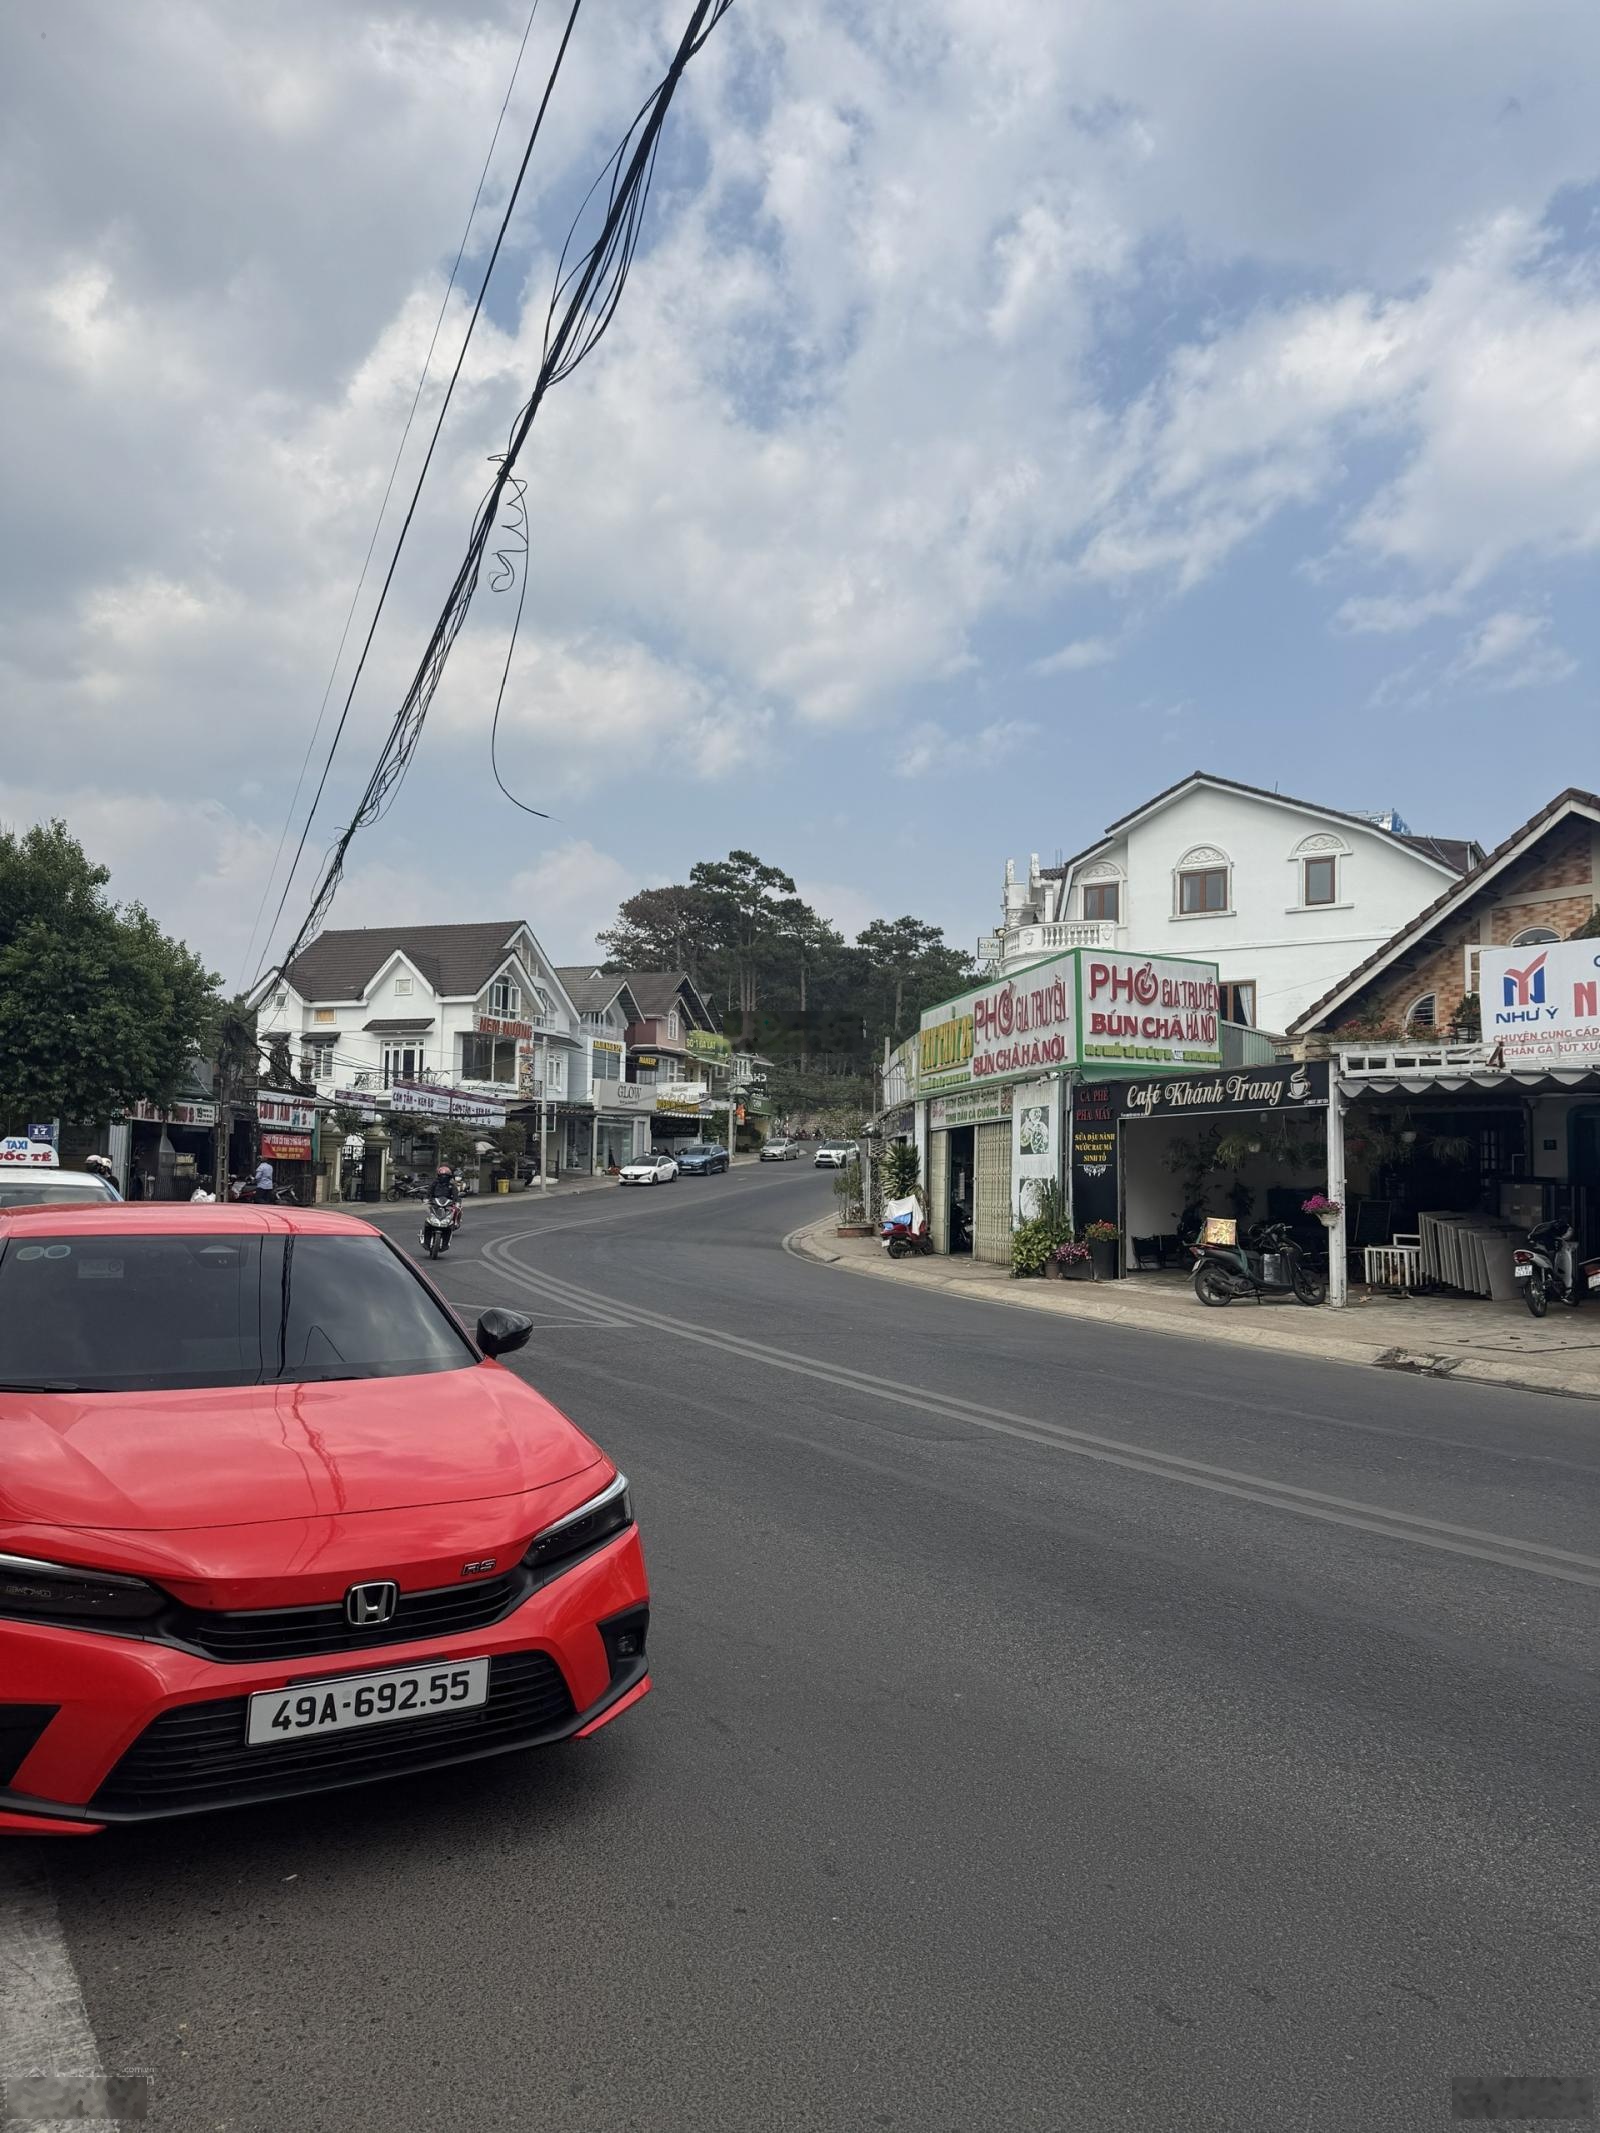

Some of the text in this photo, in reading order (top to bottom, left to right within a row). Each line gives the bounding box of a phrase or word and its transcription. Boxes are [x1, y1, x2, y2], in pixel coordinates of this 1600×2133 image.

[1090, 961, 1159, 1006] PHỞ
[1161, 978, 1180, 1007] GIA
[974, 980, 1016, 1044] PHỞ
[1015, 994, 1031, 1033] GIA
[1495, 1005, 1560, 1024] NHƯ Ý
[1090, 1008, 1138, 1037] BÚN
[1141, 1014, 1184, 1041] CHẢ
[1541, 1029, 1572, 1040] CUNG
[1575, 1025, 1600, 1038] CẤP
[973, 1049, 998, 1077] BÚN
[617, 1085, 642, 1099] GLOW
[1127, 1074, 1283, 1116] Café Khánh Trang
[33, 1127, 48, 1135] 17
[6, 1140, 28, 1150] TAXI
[31, 1150, 52, 1162] TẾ
[461, 1558, 497, 1576] RS
[271, 1670, 471, 1731] 49A-692.55
